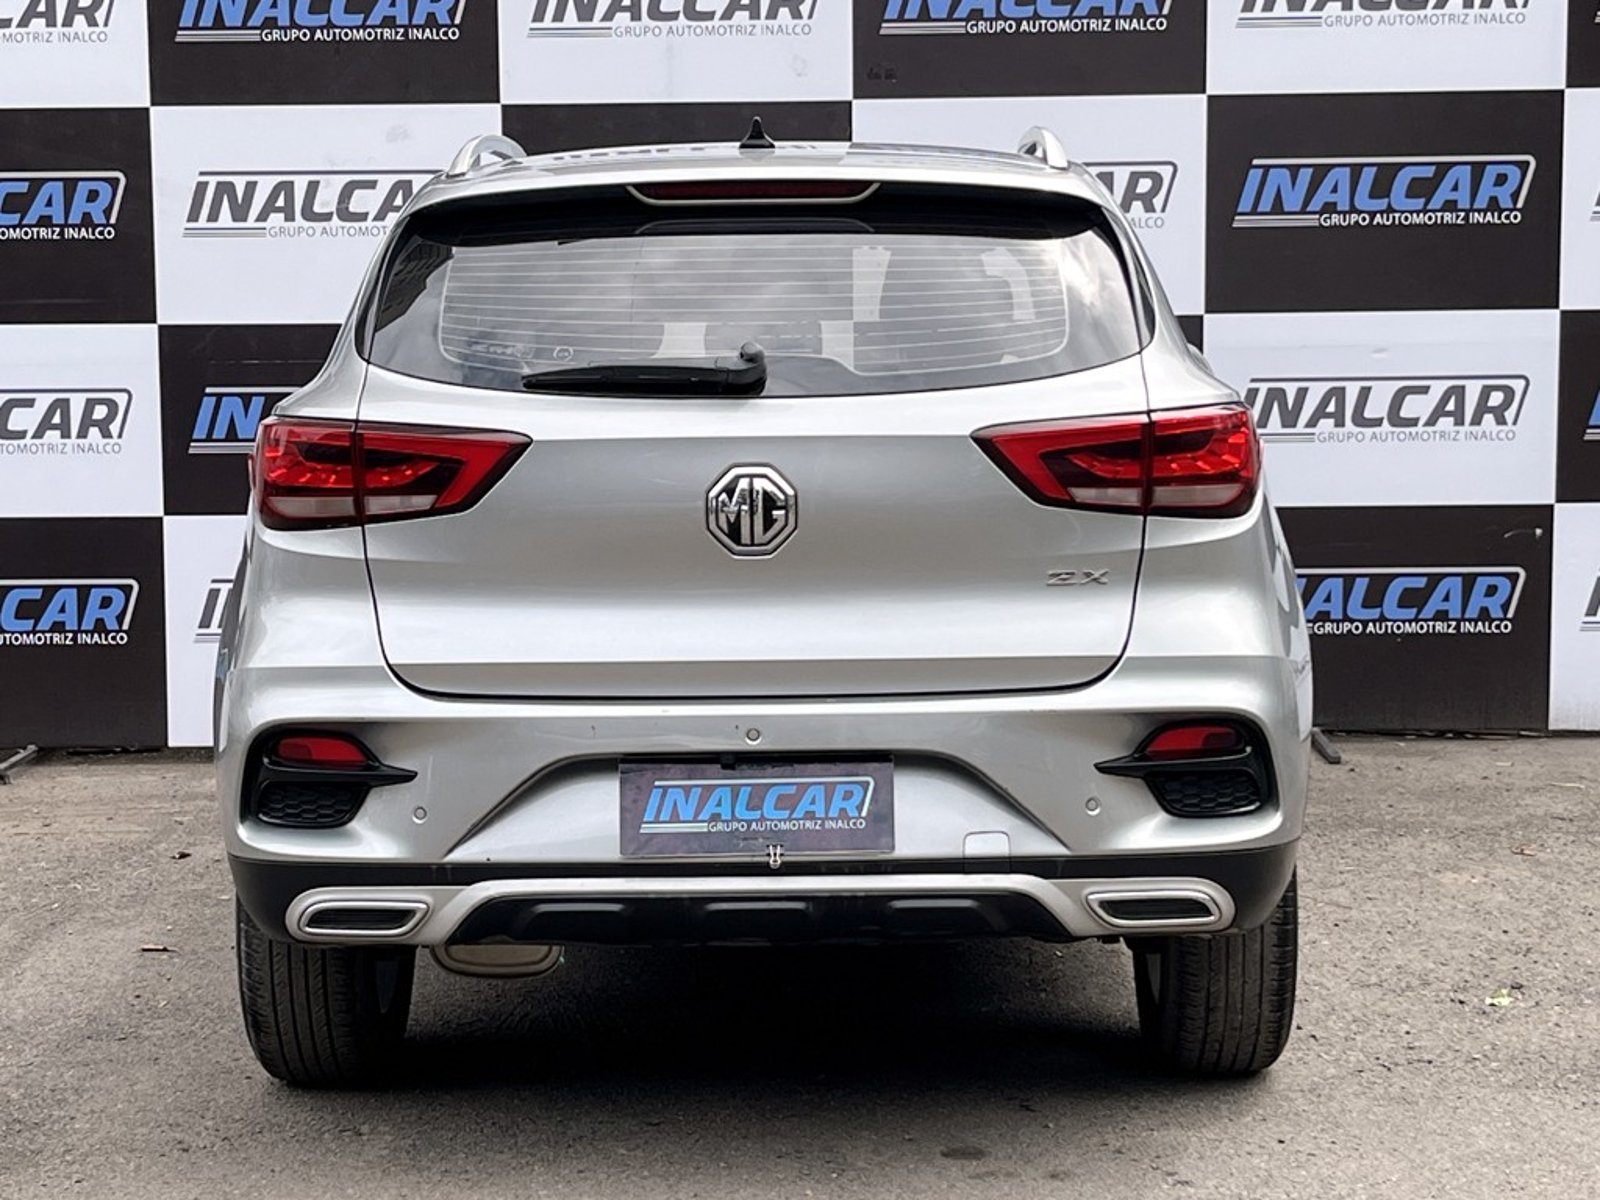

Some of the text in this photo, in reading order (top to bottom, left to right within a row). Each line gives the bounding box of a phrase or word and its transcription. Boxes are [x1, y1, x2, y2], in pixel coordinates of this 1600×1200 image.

[966, 18, 1168, 34] GRUPO AUTOMOTRIZ INALCO
[1324, 12, 1526, 28] GRUPO AUTOMOTRIZ INALCO
[57, 31, 108, 43] INALCO
[262, 27, 460, 42] GRUPO AUTOMOTRIZ INALCO
[613, 24, 812, 38] GRUPO AUTOMOTRIZ INALCO
[1236, 164, 1523, 213] INALCAR
[1319, 211, 1522, 228] GRUPO AUTOMOTRIZ INALCO
[64, 227, 115, 240] INALCO
[268, 227, 316, 238] GRUPO
[1316, 428, 1517, 444] GRUPO AUTOMOTRIZ INALCO
[72, 442, 122, 454] INALCO
[713, 472, 790, 549] MG
[1045, 568, 1109, 587] ZX
[0, 587, 126, 632] CAR
[1313, 620, 1513, 635] GRUPO AUTOMOTRIZ INALCO
[77, 632, 128, 645] INALCO
[643, 783, 865, 822] INALCAR
[708, 819, 866, 833] GRUPO AUTOMOTRIZ INALCO
